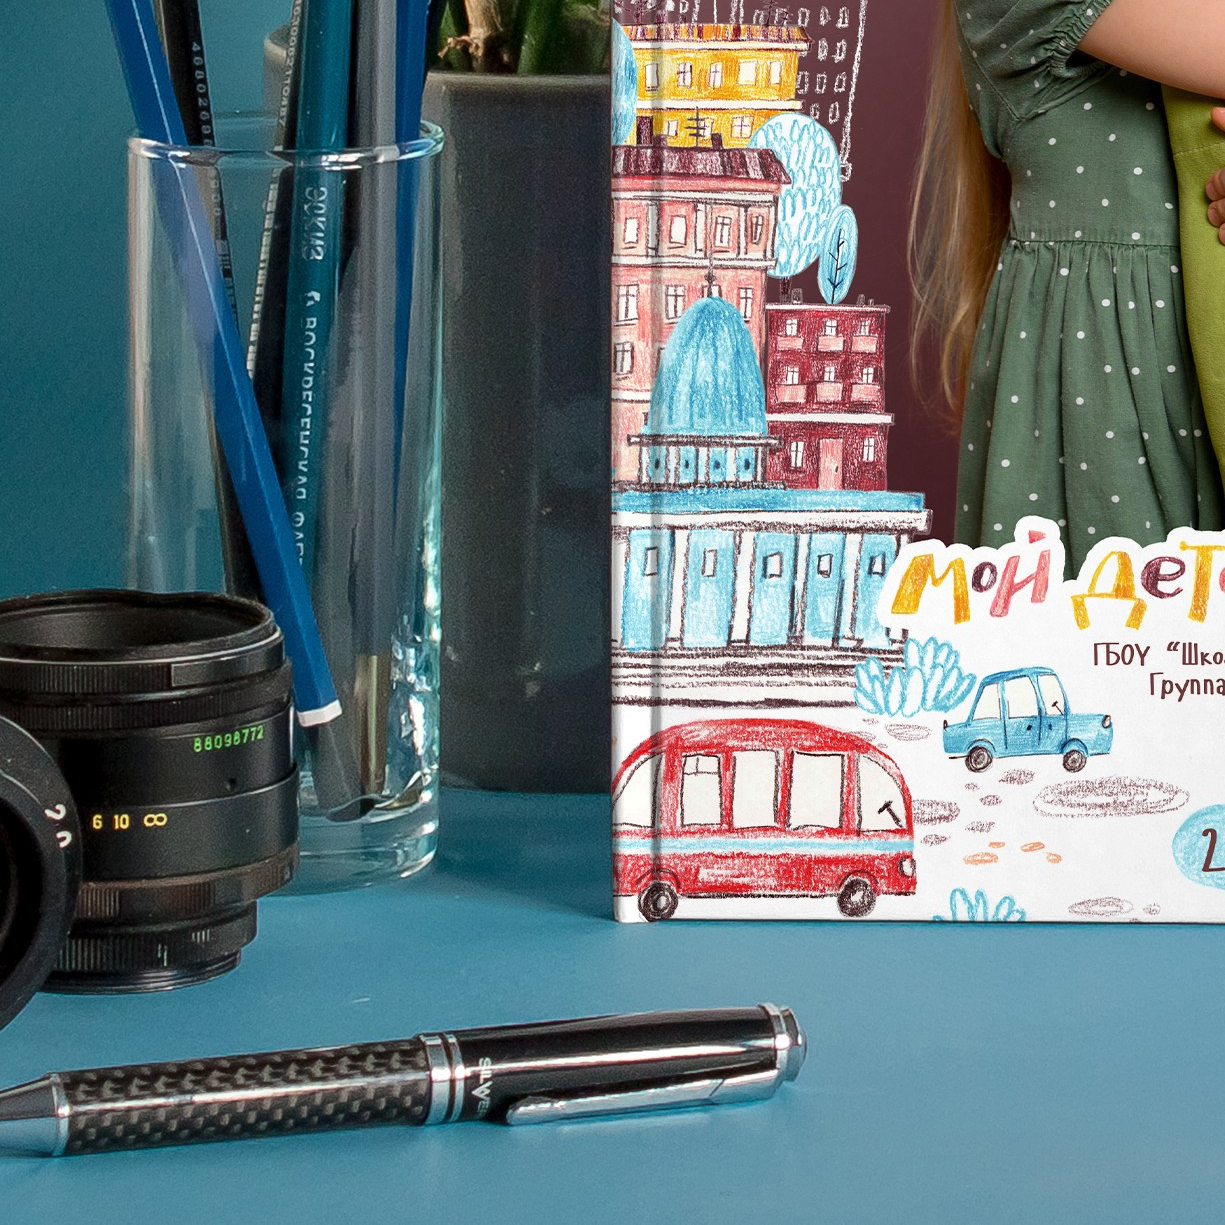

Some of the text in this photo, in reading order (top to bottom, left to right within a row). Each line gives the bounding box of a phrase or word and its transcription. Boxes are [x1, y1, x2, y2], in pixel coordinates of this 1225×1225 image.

[1093, 642, 1151, 667] ГБОУ
[193, 725, 265, 753] 88098772
[92, 814, 103, 830] 6
[113, 814, 130, 830] 10
